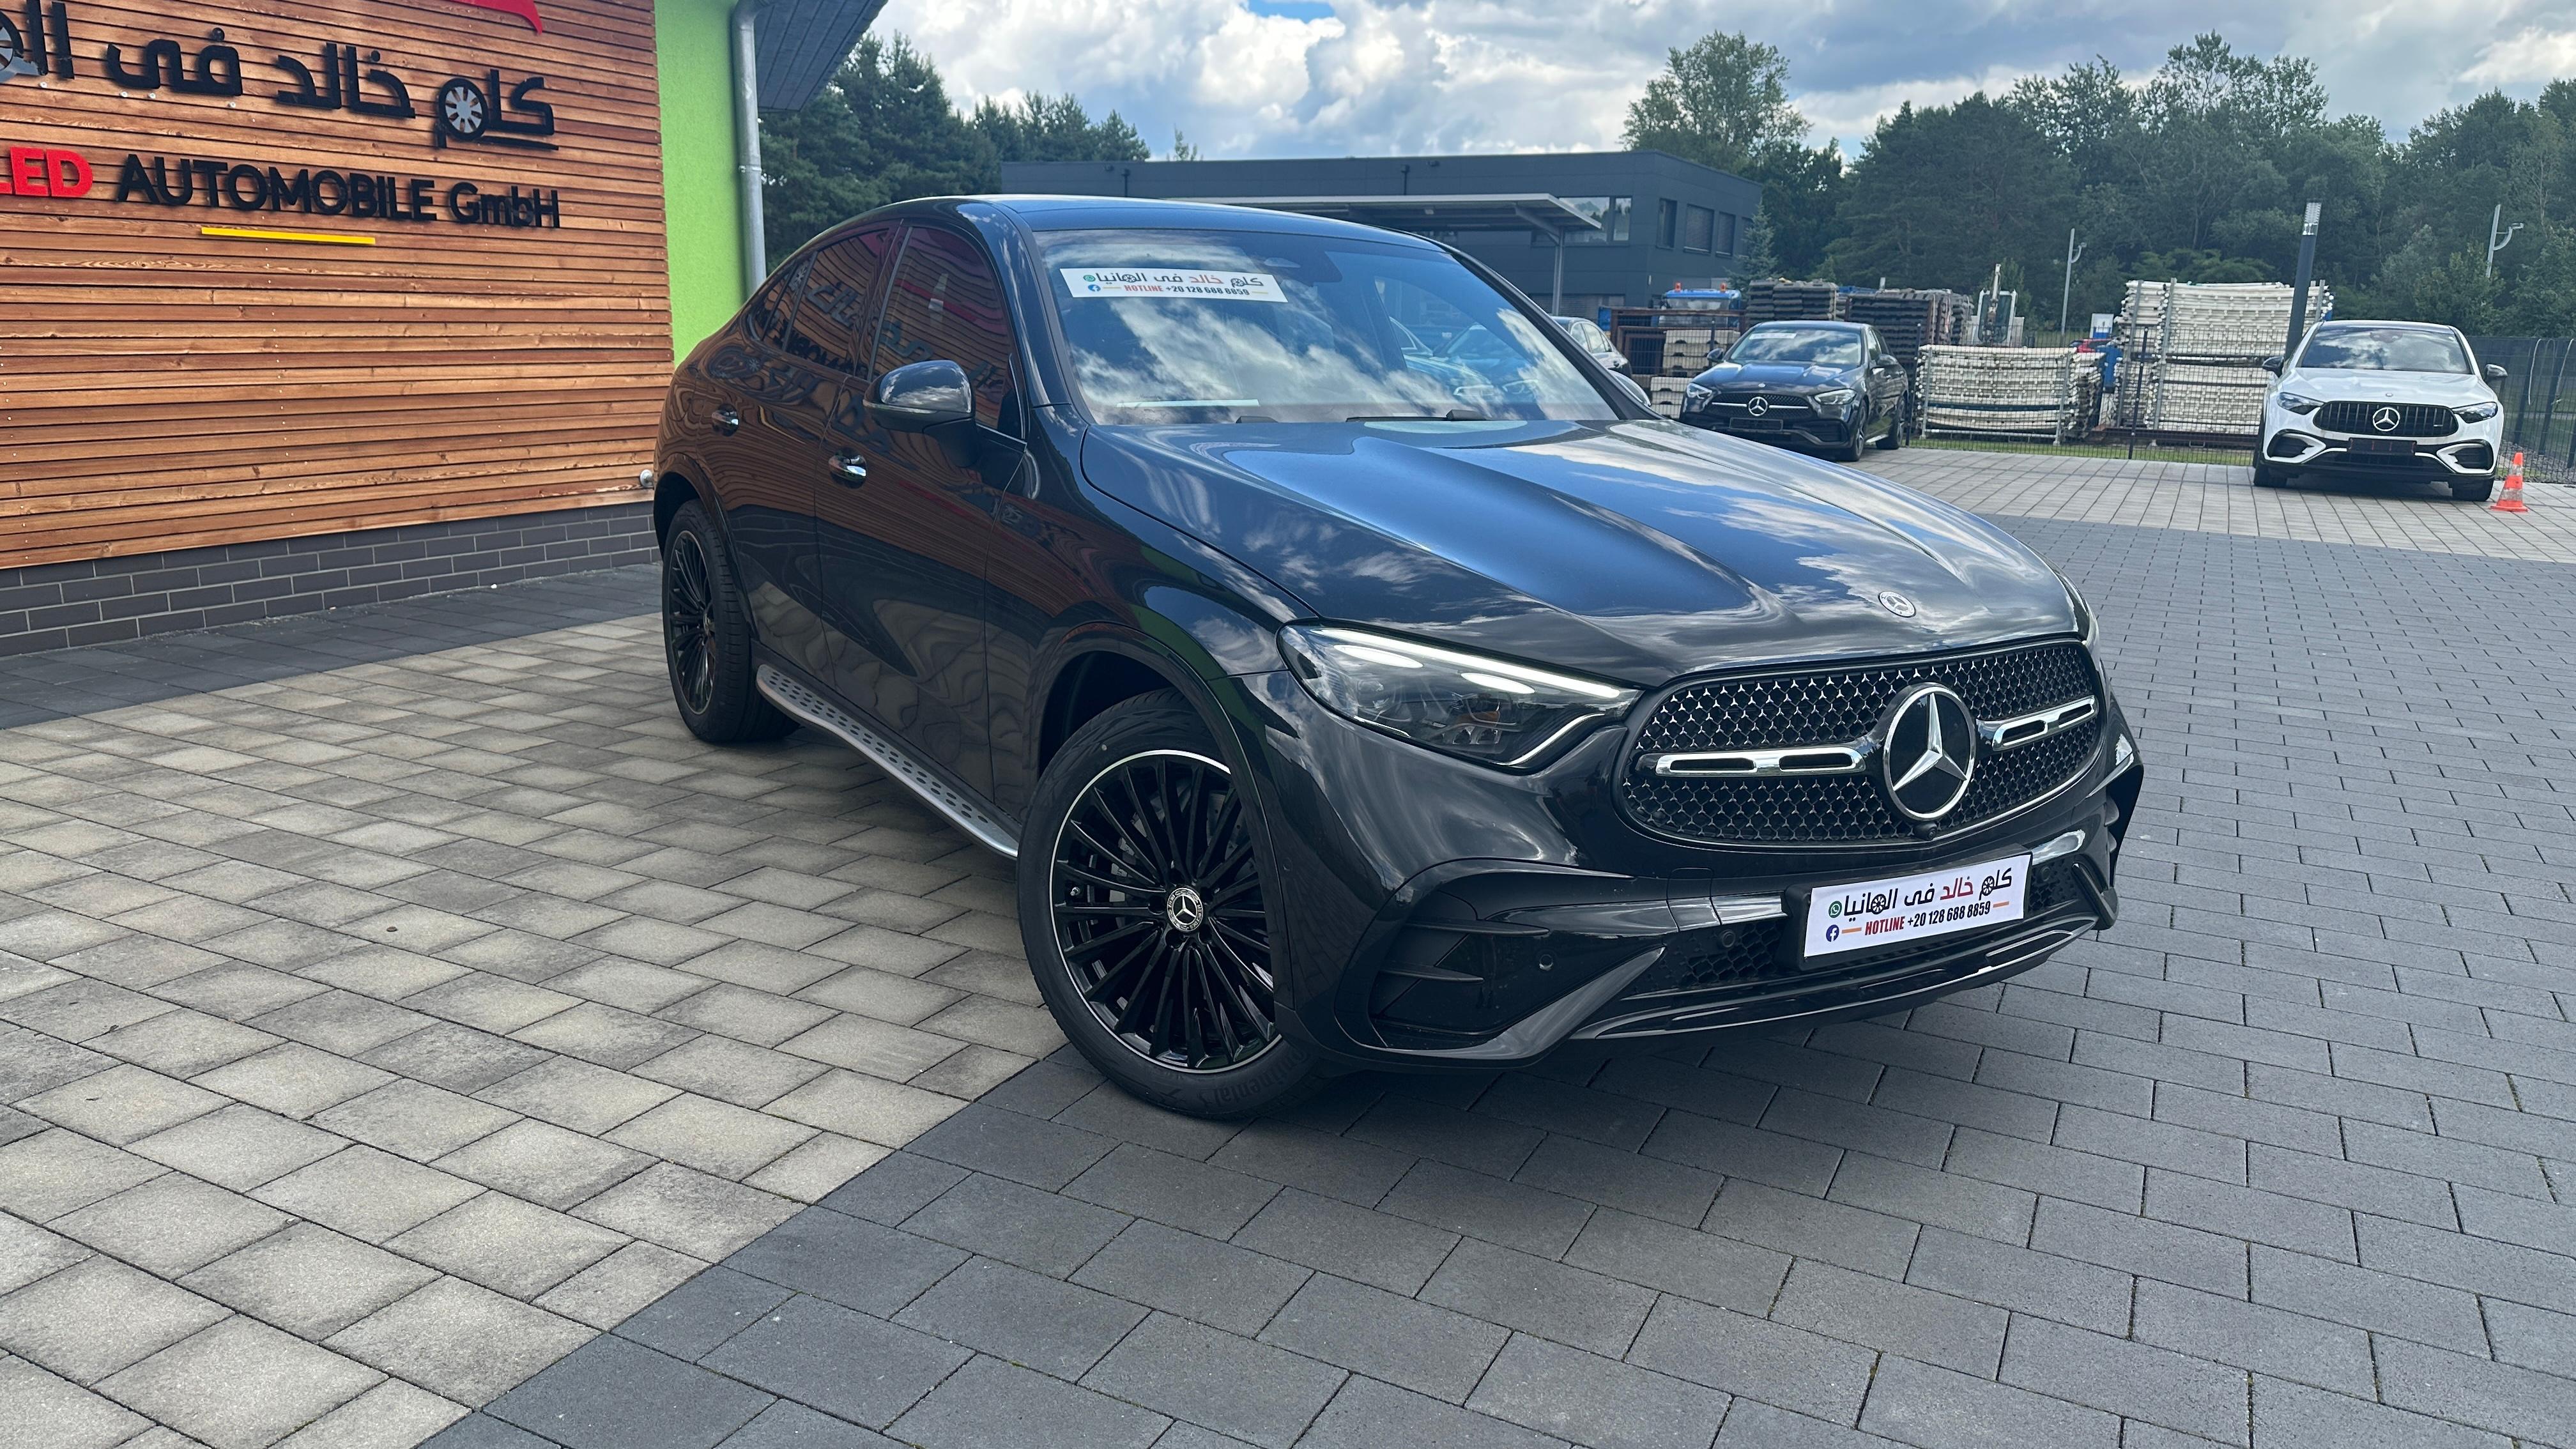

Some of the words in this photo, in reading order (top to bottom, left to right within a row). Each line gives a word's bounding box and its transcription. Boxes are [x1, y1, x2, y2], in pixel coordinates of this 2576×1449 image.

[277, 42, 416, 119] خالد
[118, 154, 437, 222] AUTOMOBILE
[449, 182, 560, 229] GmbH
[1189, 274, 1223, 284] خالد
[1844, 888, 1899, 922] المانيا
[1940, 876, 1974, 900] خالد
[1864, 916, 1905, 935] HOTLINE
[1907, 912, 1926, 928] +20
[1928, 908, 1945, 925] 128
[1947, 905, 1965, 922] 688
[1966, 900, 1991, 918] 8859
